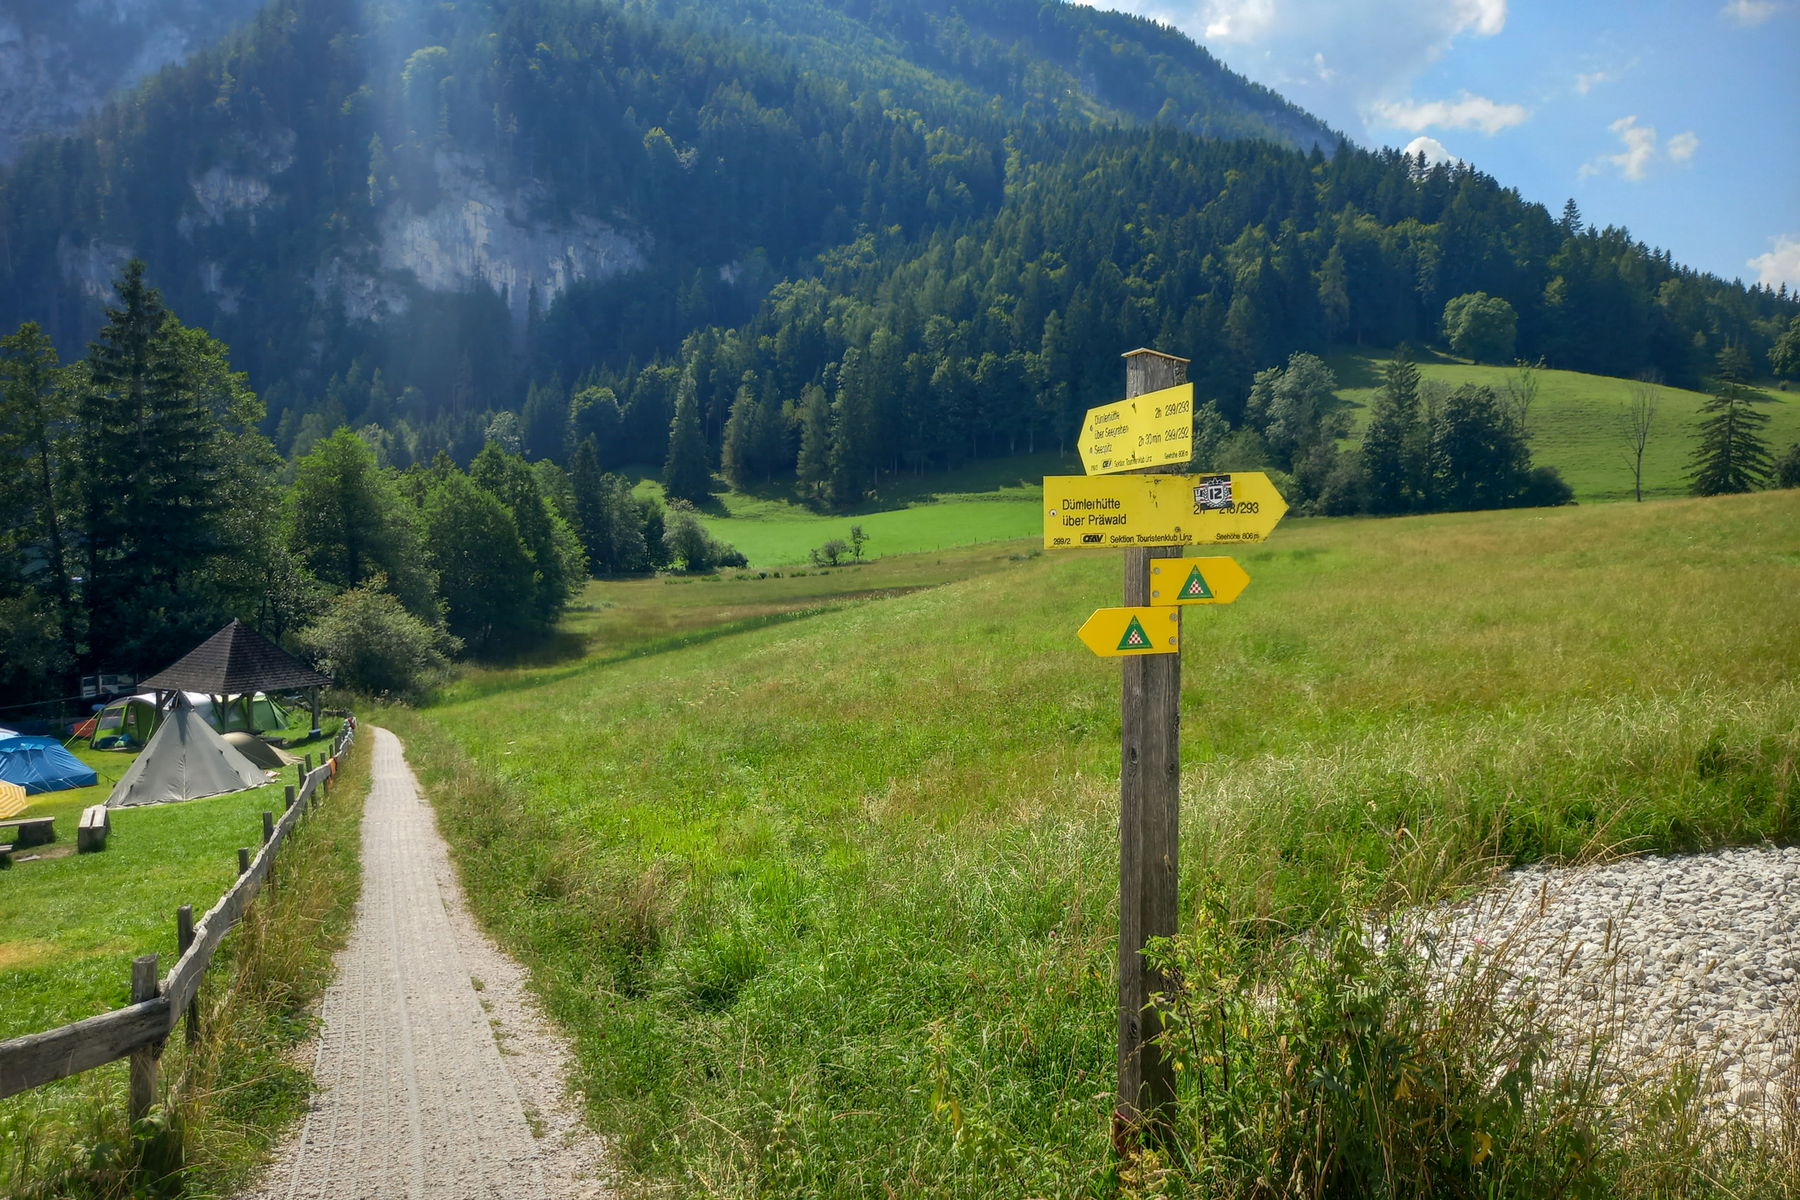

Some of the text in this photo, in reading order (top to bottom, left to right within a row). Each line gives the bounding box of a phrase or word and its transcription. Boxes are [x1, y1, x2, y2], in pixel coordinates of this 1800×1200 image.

[1165, 400, 1190, 416] 299/293
[1165, 426, 1189, 441] 299/292
[1209, 487, 1222, 500] 12
[1062, 498, 1121, 510] Dümlerhütte
[1062, 513, 1127, 526] über Präwald
[1110, 535, 1134, 543] Sektion
[1136, 532, 1178, 543] Touristenklub
[1179, 533, 1192, 541] Linz
[1216, 532, 1240, 540] Seehöhe
